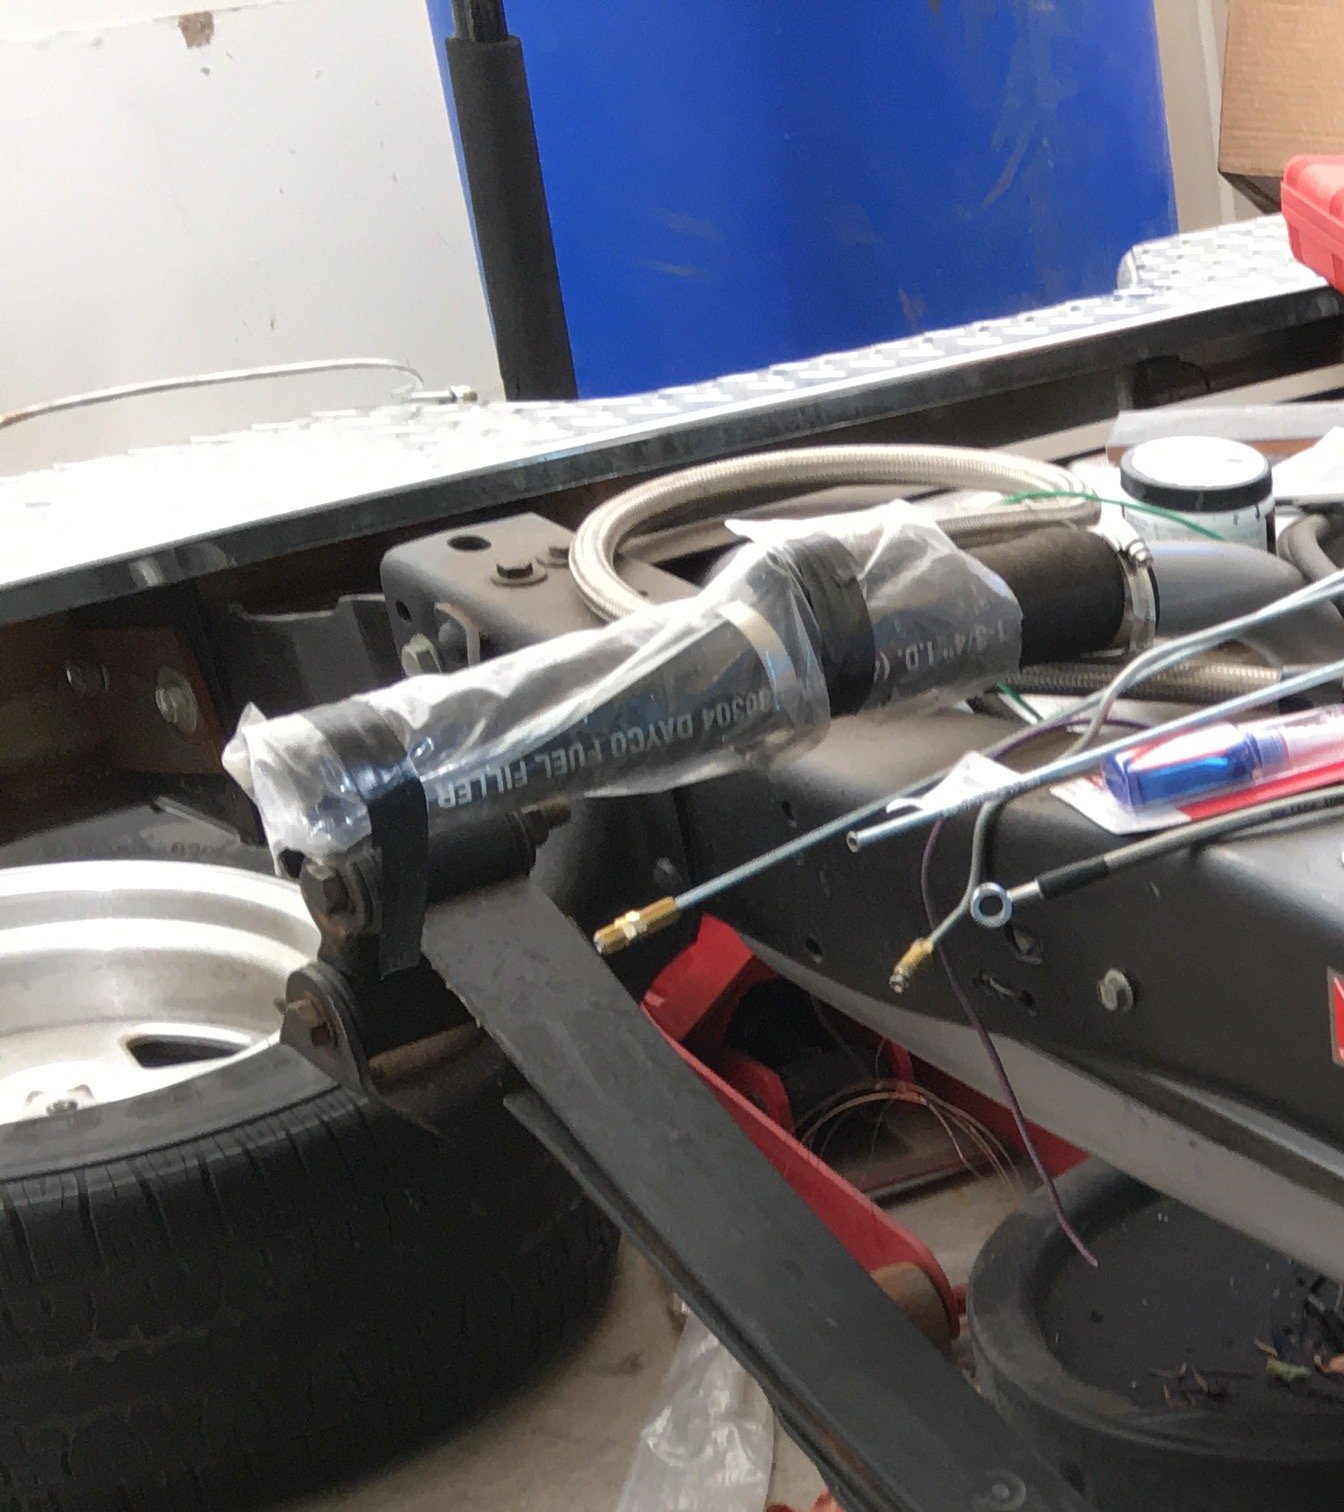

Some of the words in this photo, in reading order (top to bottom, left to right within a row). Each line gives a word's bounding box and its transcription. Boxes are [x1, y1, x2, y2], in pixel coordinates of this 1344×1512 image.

[535, 738, 601, 778] FUEL
[610, 712, 694, 758] DAYCO
[436, 759, 529, 809] FILLER
